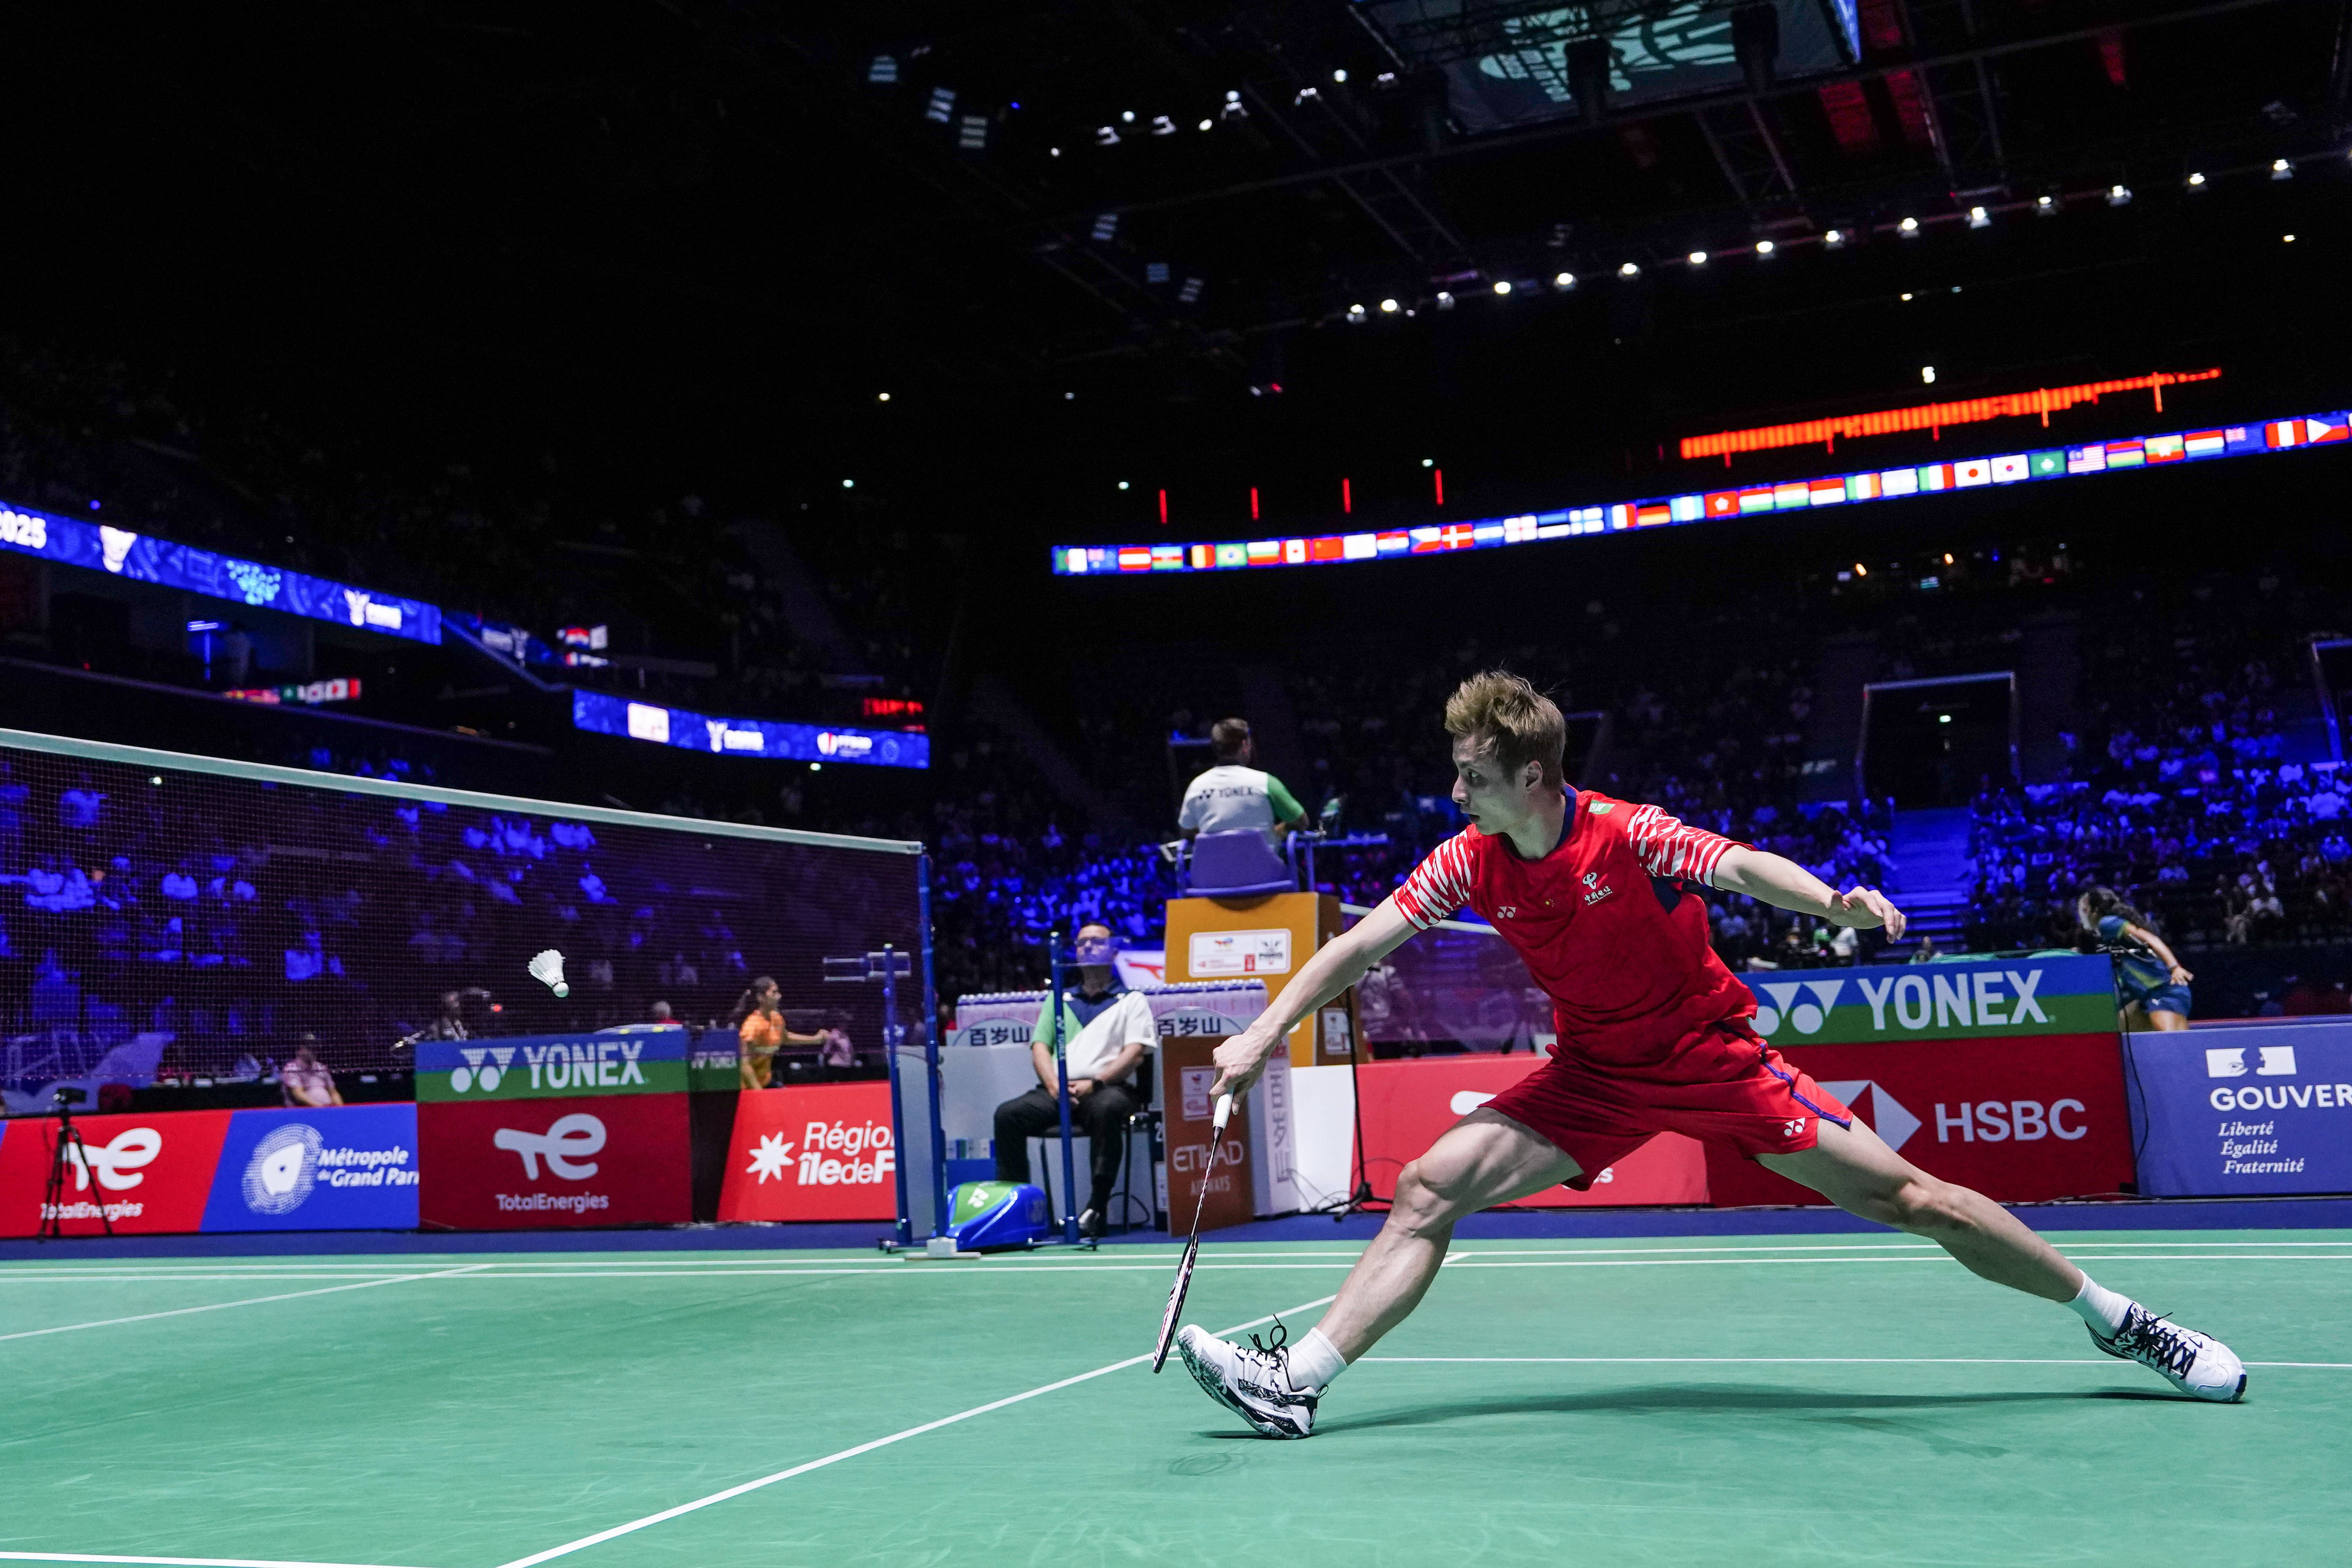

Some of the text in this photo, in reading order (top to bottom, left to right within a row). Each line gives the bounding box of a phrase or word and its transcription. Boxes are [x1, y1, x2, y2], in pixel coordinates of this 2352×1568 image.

[0, 510, 47, 549] 025
[1857, 969, 2049, 1030] YONEX
[969, 1026, 1030, 1046] 百岁山
[1157, 1016, 1221, 1037] 百岁山
[523, 1040, 645, 1090] YONEX
[2210, 1084, 2352, 1112] GOUVER
[1934, 1098, 2088, 1143] HSBC
[2218, 1120, 2274, 1136] Liberté
[317, 1146, 409, 1170] Métropole
[1173, 1140, 1244, 1172] ETIHAD
[2220, 1138, 2278, 1159] Égalité
[330, 1167, 385, 1187] Grand
[2222, 1157, 2305, 1174] Fraternité
[495, 1191, 609, 1213] TotalEnergies
